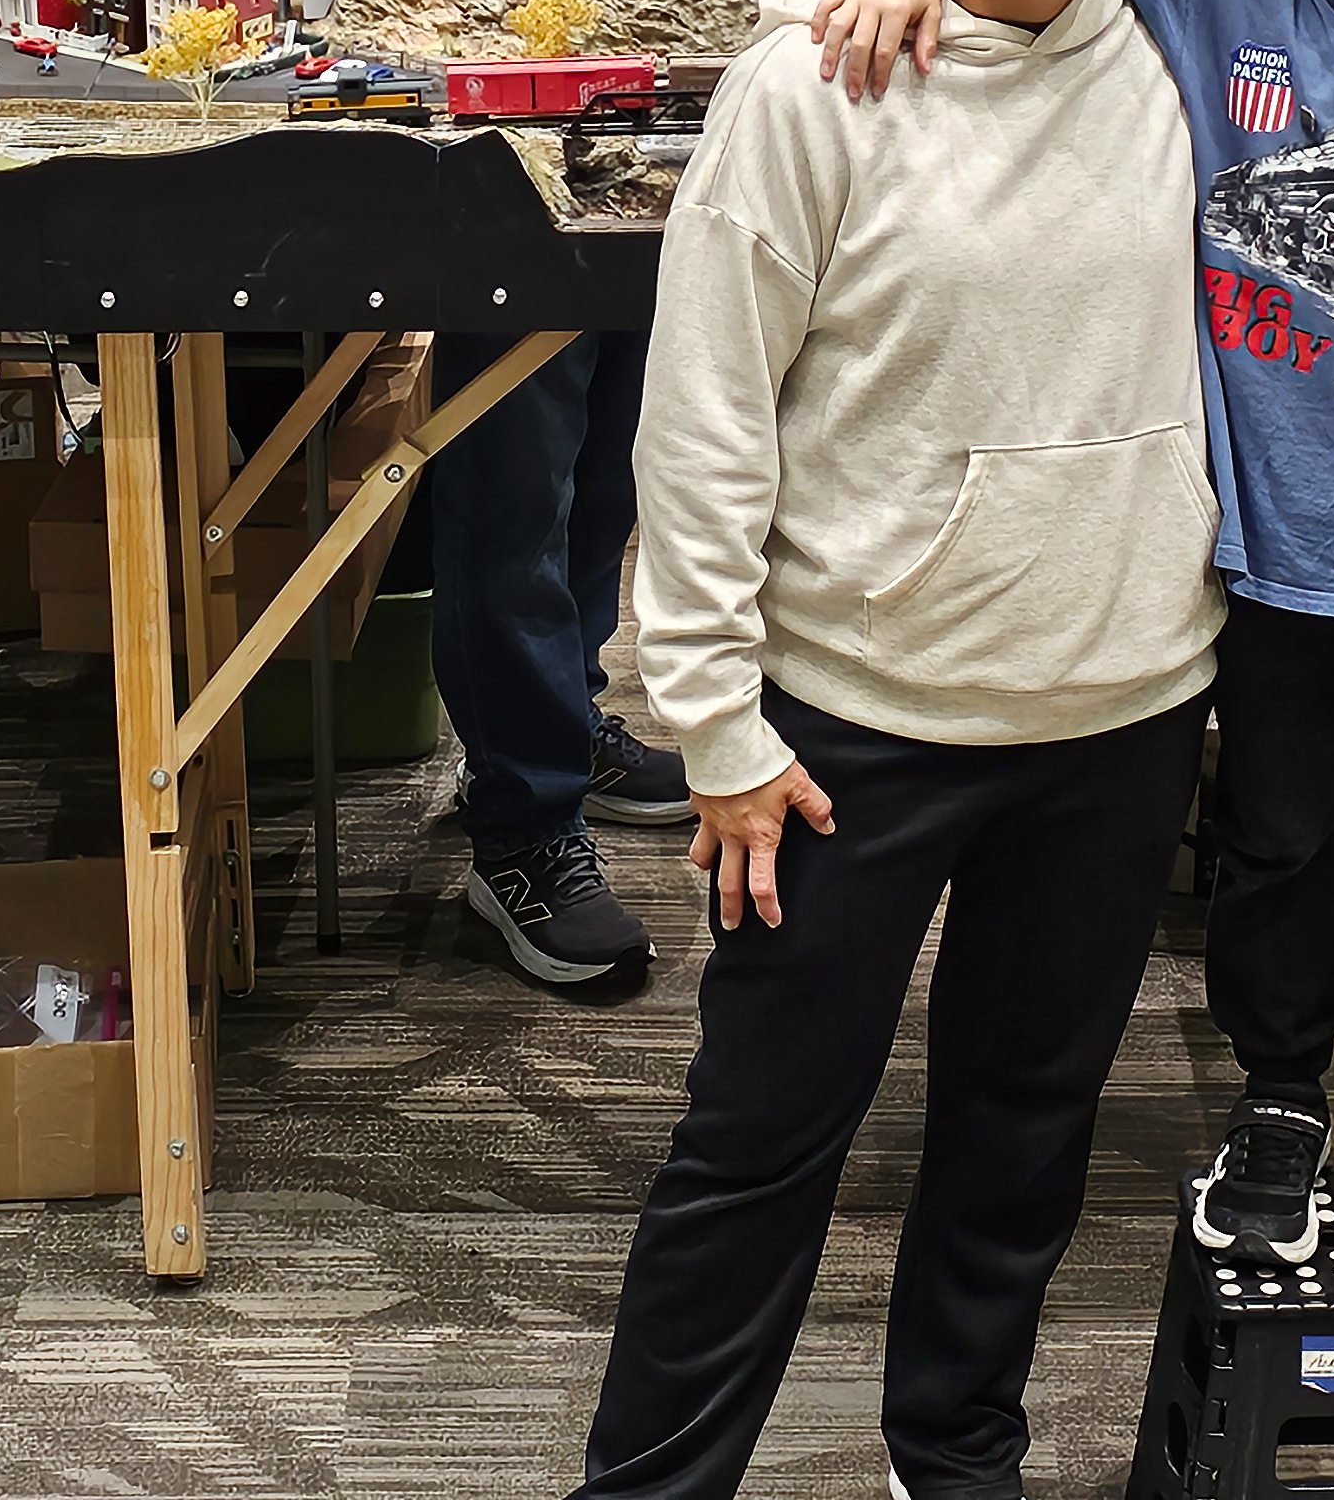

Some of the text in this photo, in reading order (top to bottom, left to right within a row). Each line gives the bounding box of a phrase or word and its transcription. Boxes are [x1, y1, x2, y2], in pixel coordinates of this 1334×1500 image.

[1232, 61, 1291, 86] PACIFIC
[1239, 47, 1288, 69] UNION
[1204, 266, 1294, 328] BIG
[1211, 305, 1334, 374] BOY
